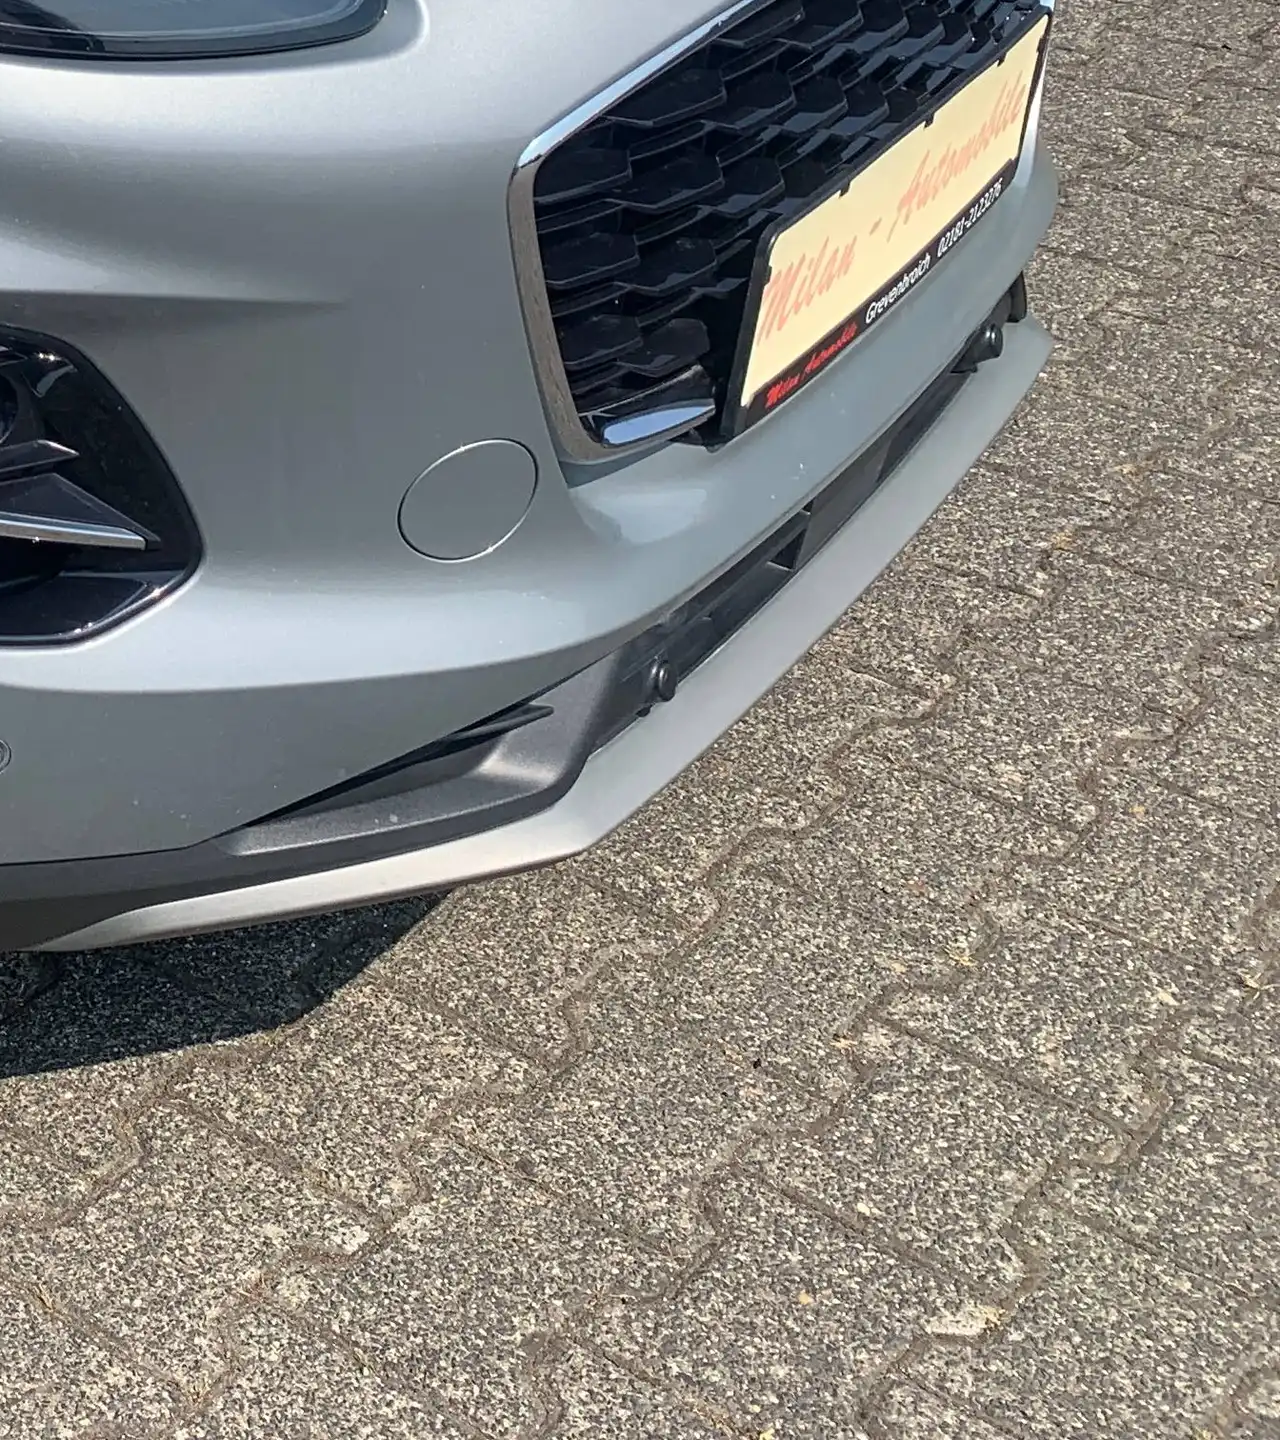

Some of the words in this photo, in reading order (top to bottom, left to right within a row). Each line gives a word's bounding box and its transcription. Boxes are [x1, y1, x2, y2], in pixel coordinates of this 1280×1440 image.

[756, 235, 859, 347] Milan
[886, 69, 1028, 244] Automobile
[865, 251, 931, 324] Grevenbroich
[936, 177, 1003, 258] 02181-2123276
